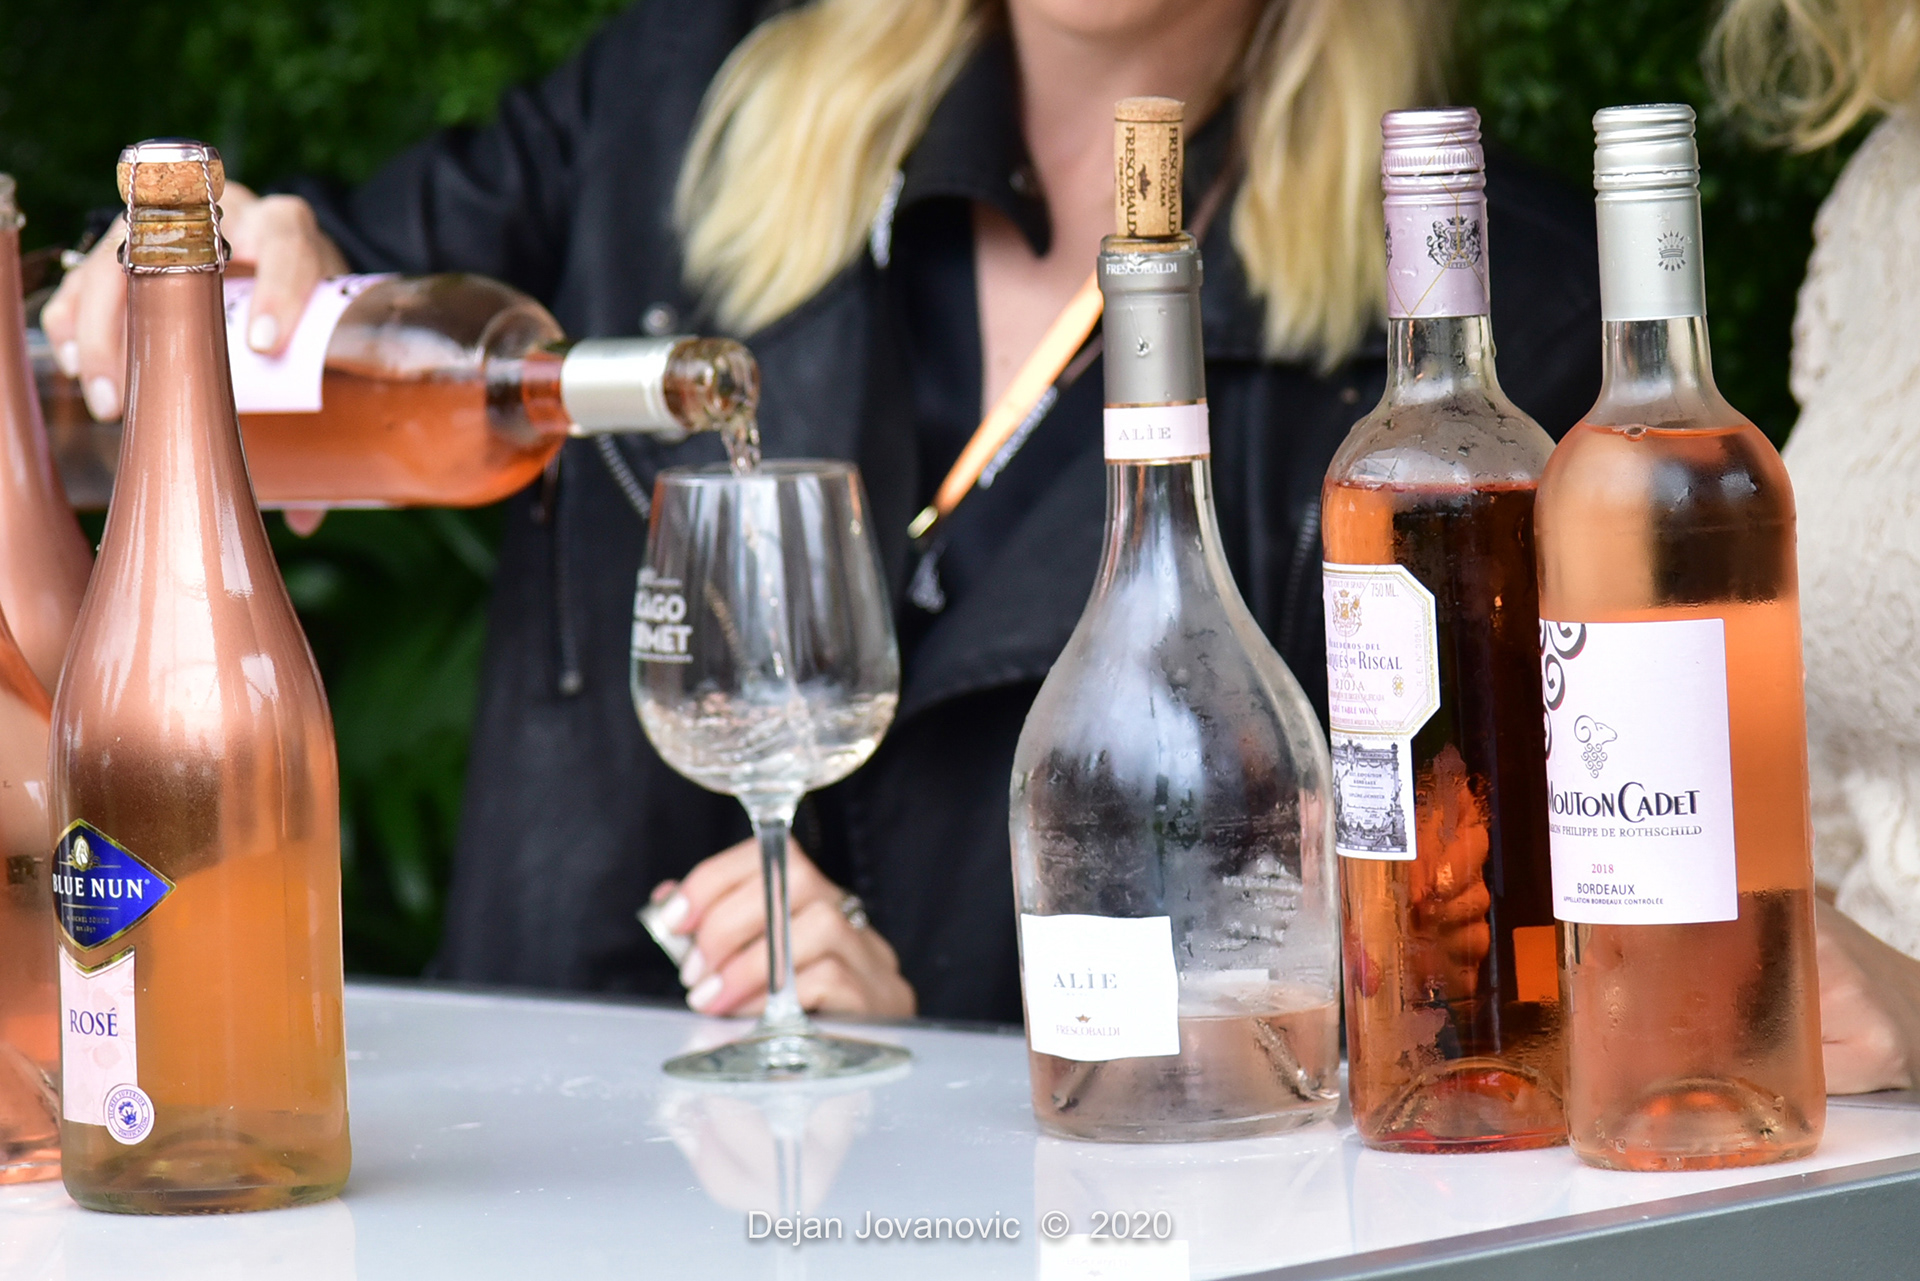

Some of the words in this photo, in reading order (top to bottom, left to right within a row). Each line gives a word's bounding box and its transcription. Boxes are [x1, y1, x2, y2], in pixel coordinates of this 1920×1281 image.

[1168, 127, 1178, 233] FRESCOBALD
[1106, 262, 1177, 275] FRESCOBALDI
[1371, 583, 1384, 597] 750
[1350, 657, 1357, 665] DE
[1358, 651, 1403, 670] RISCAL
[1359, 707, 1378, 715] WINE
[1618, 782, 1701, 823] CADET
[1562, 825, 1599, 837] PHILIPPE
[1601, 828, 1615, 837] DE
[1619, 825, 1703, 837] ROTHSCHILD
[1591, 863, 1615, 874] 2018
[52, 873, 85, 897] BLUE
[1577, 883, 1636, 895] BORDEAUX
[1591, 897, 1622, 905] BORDEAUX
[1624, 896, 1664, 905] CONTRÔLÉE
[69, 1007, 119, 1037] ROSÉ
[1056, 1024, 1121, 1037] FRESCOBALDI
